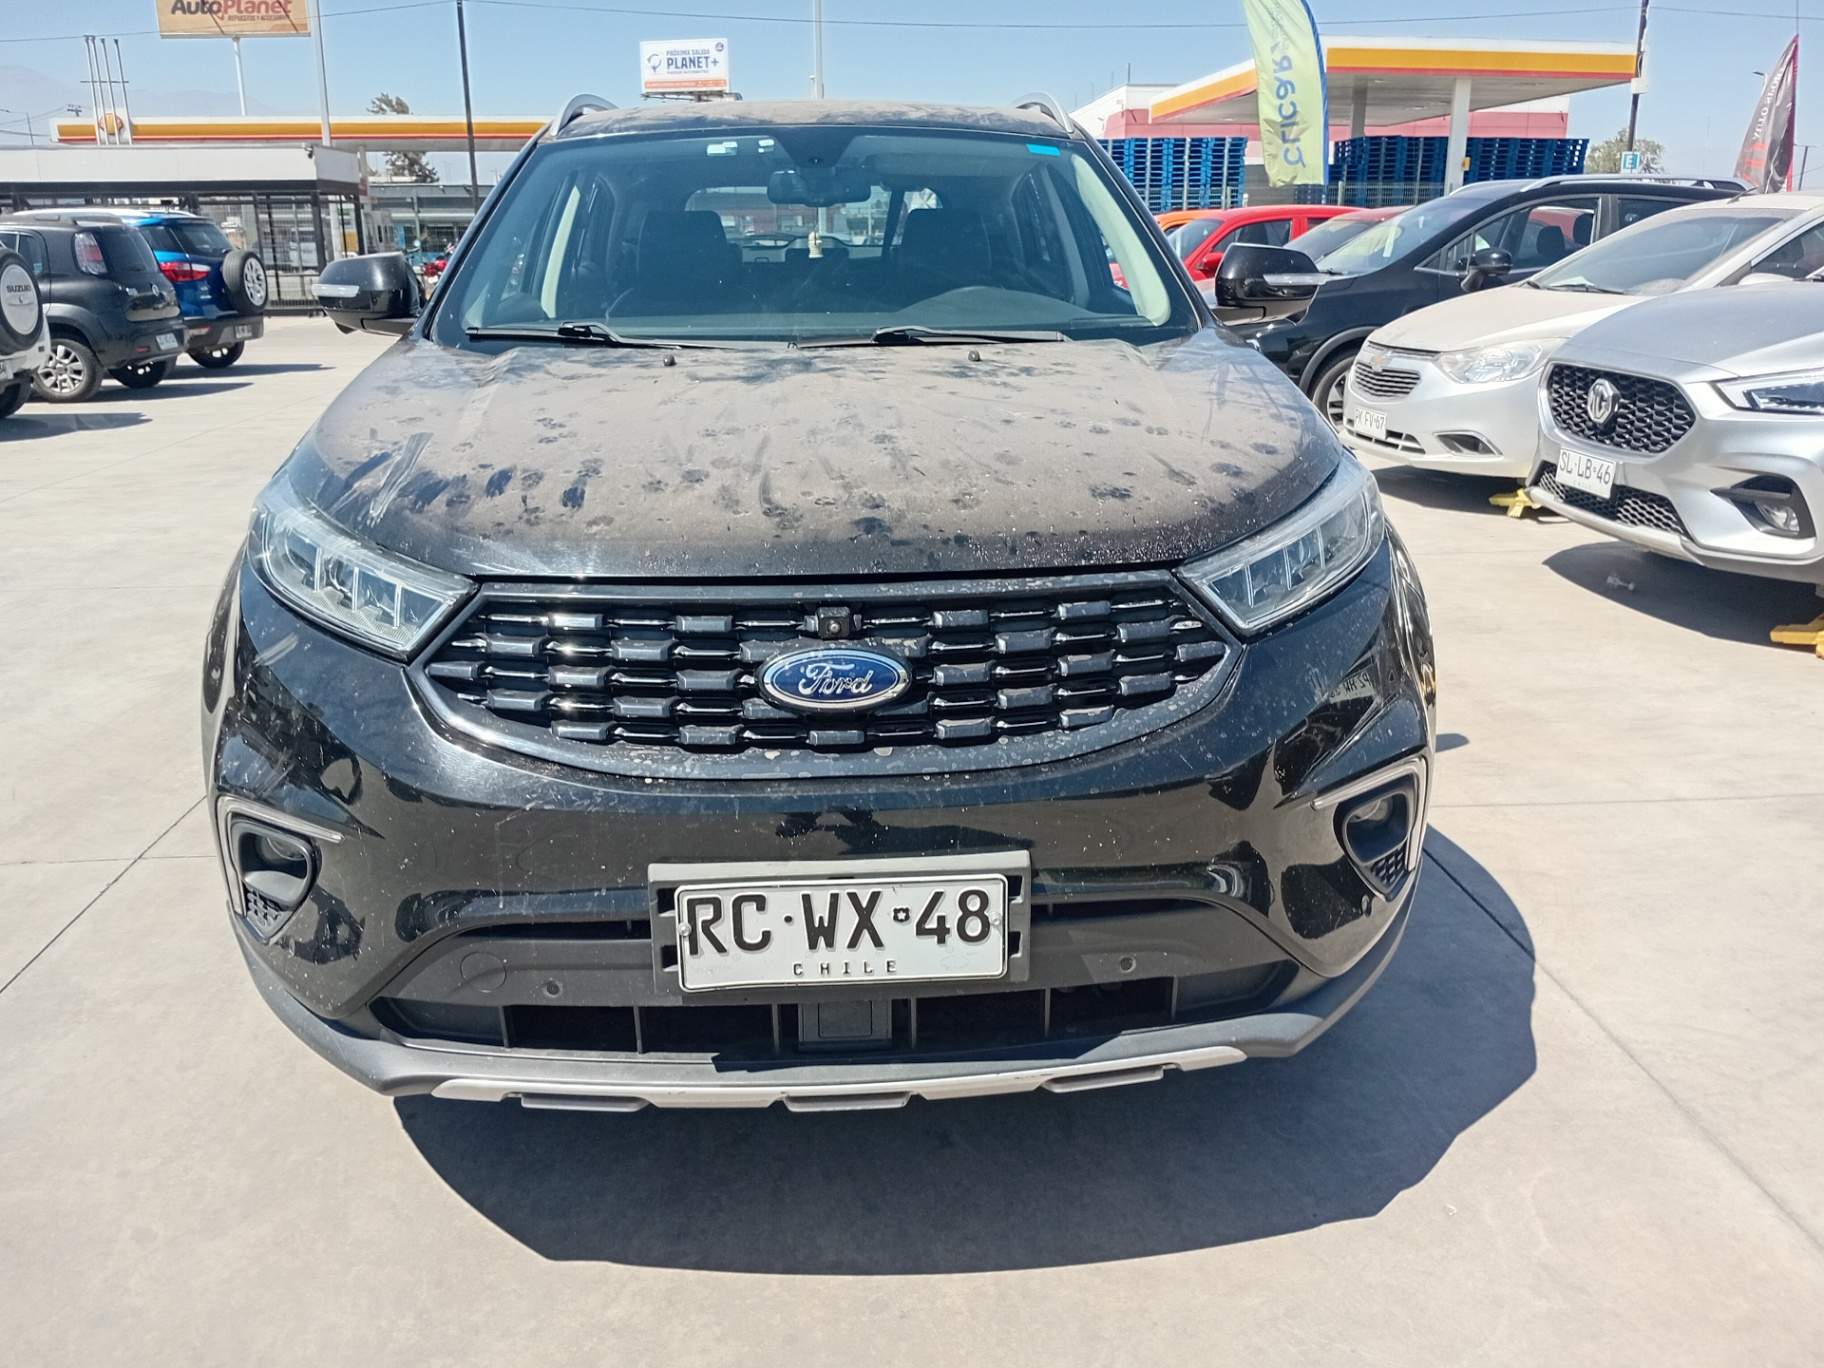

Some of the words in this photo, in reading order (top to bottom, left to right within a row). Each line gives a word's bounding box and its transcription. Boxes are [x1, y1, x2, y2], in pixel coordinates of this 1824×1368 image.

[171, 0, 292, 15] AutoPlanet
[798, 662, 874, 695] Ford
[793, 960, 897, 976] CHILE
